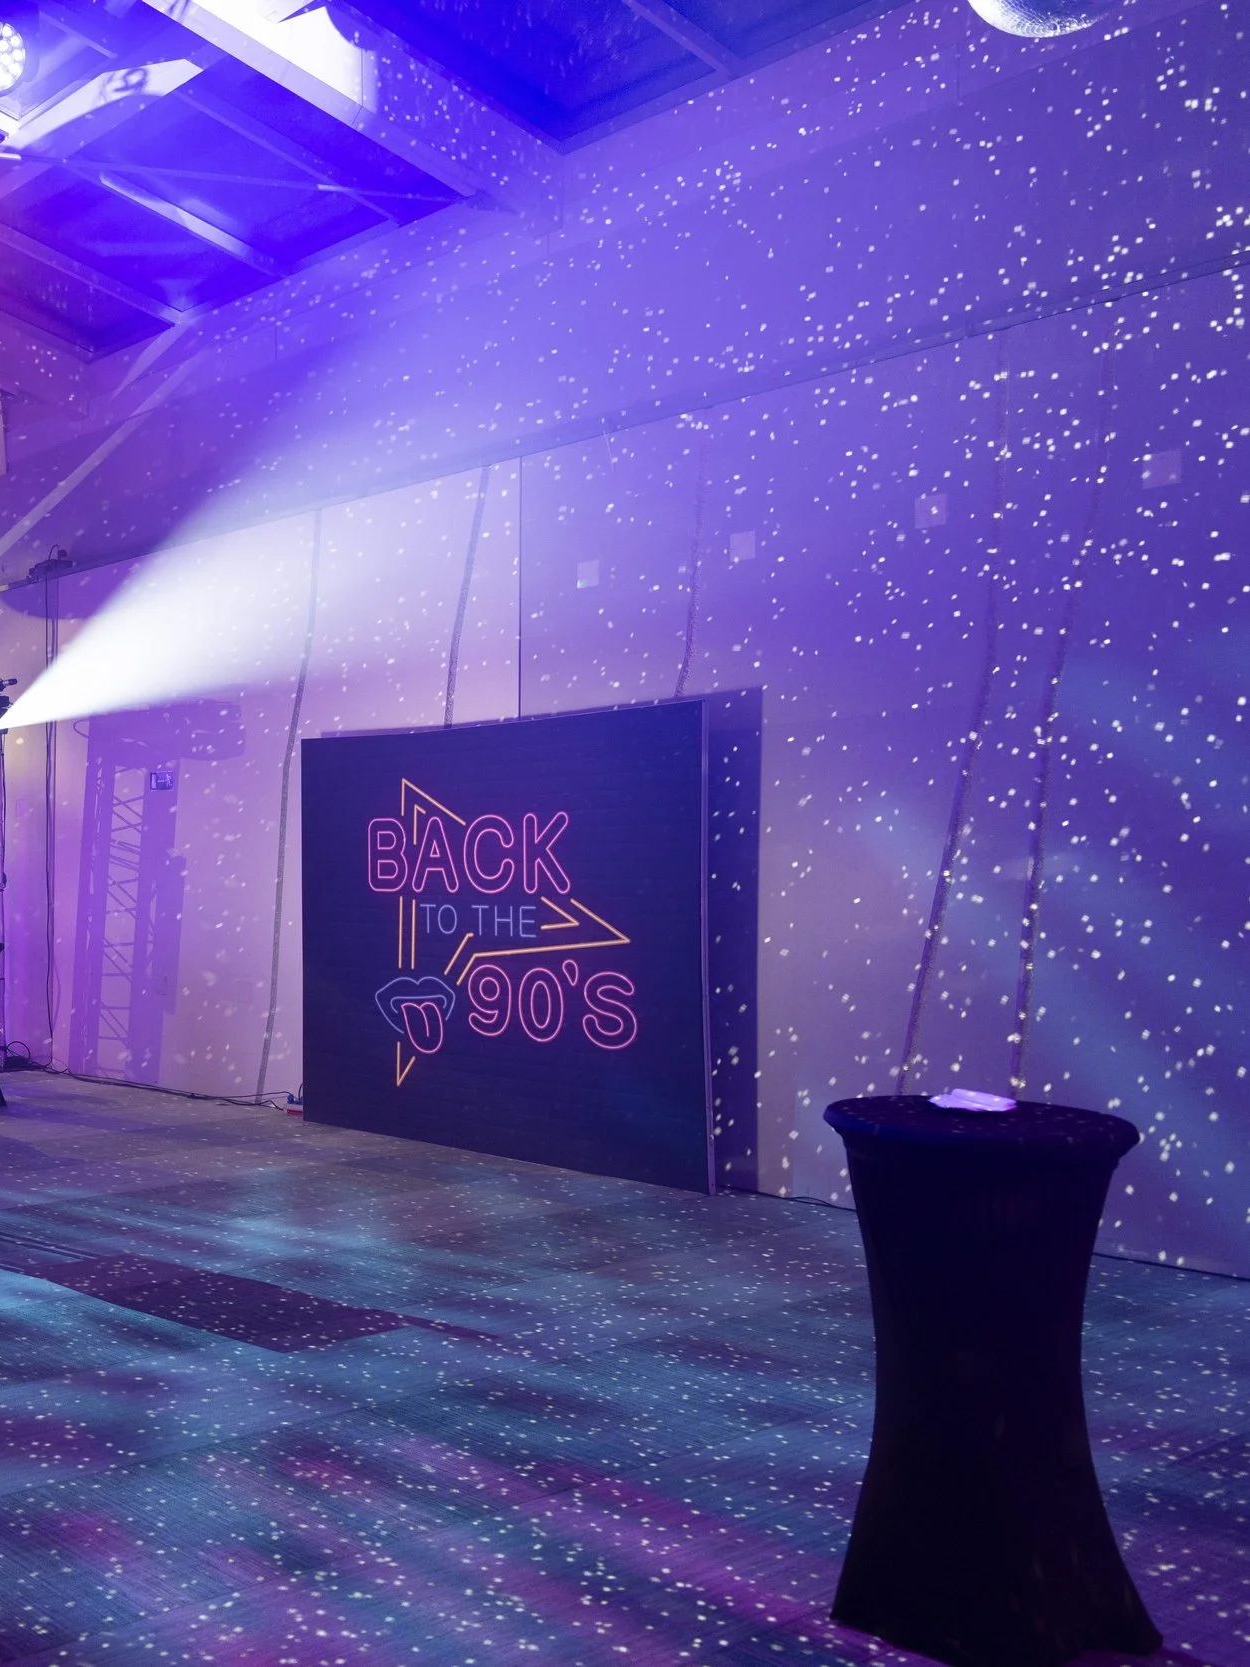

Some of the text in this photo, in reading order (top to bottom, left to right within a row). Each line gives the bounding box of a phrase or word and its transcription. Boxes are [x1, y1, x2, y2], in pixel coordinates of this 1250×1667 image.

[368, 811, 571, 894] BACK
[419, 903, 537, 938] TO THE
[468, 959, 638, 1049] 90'S
